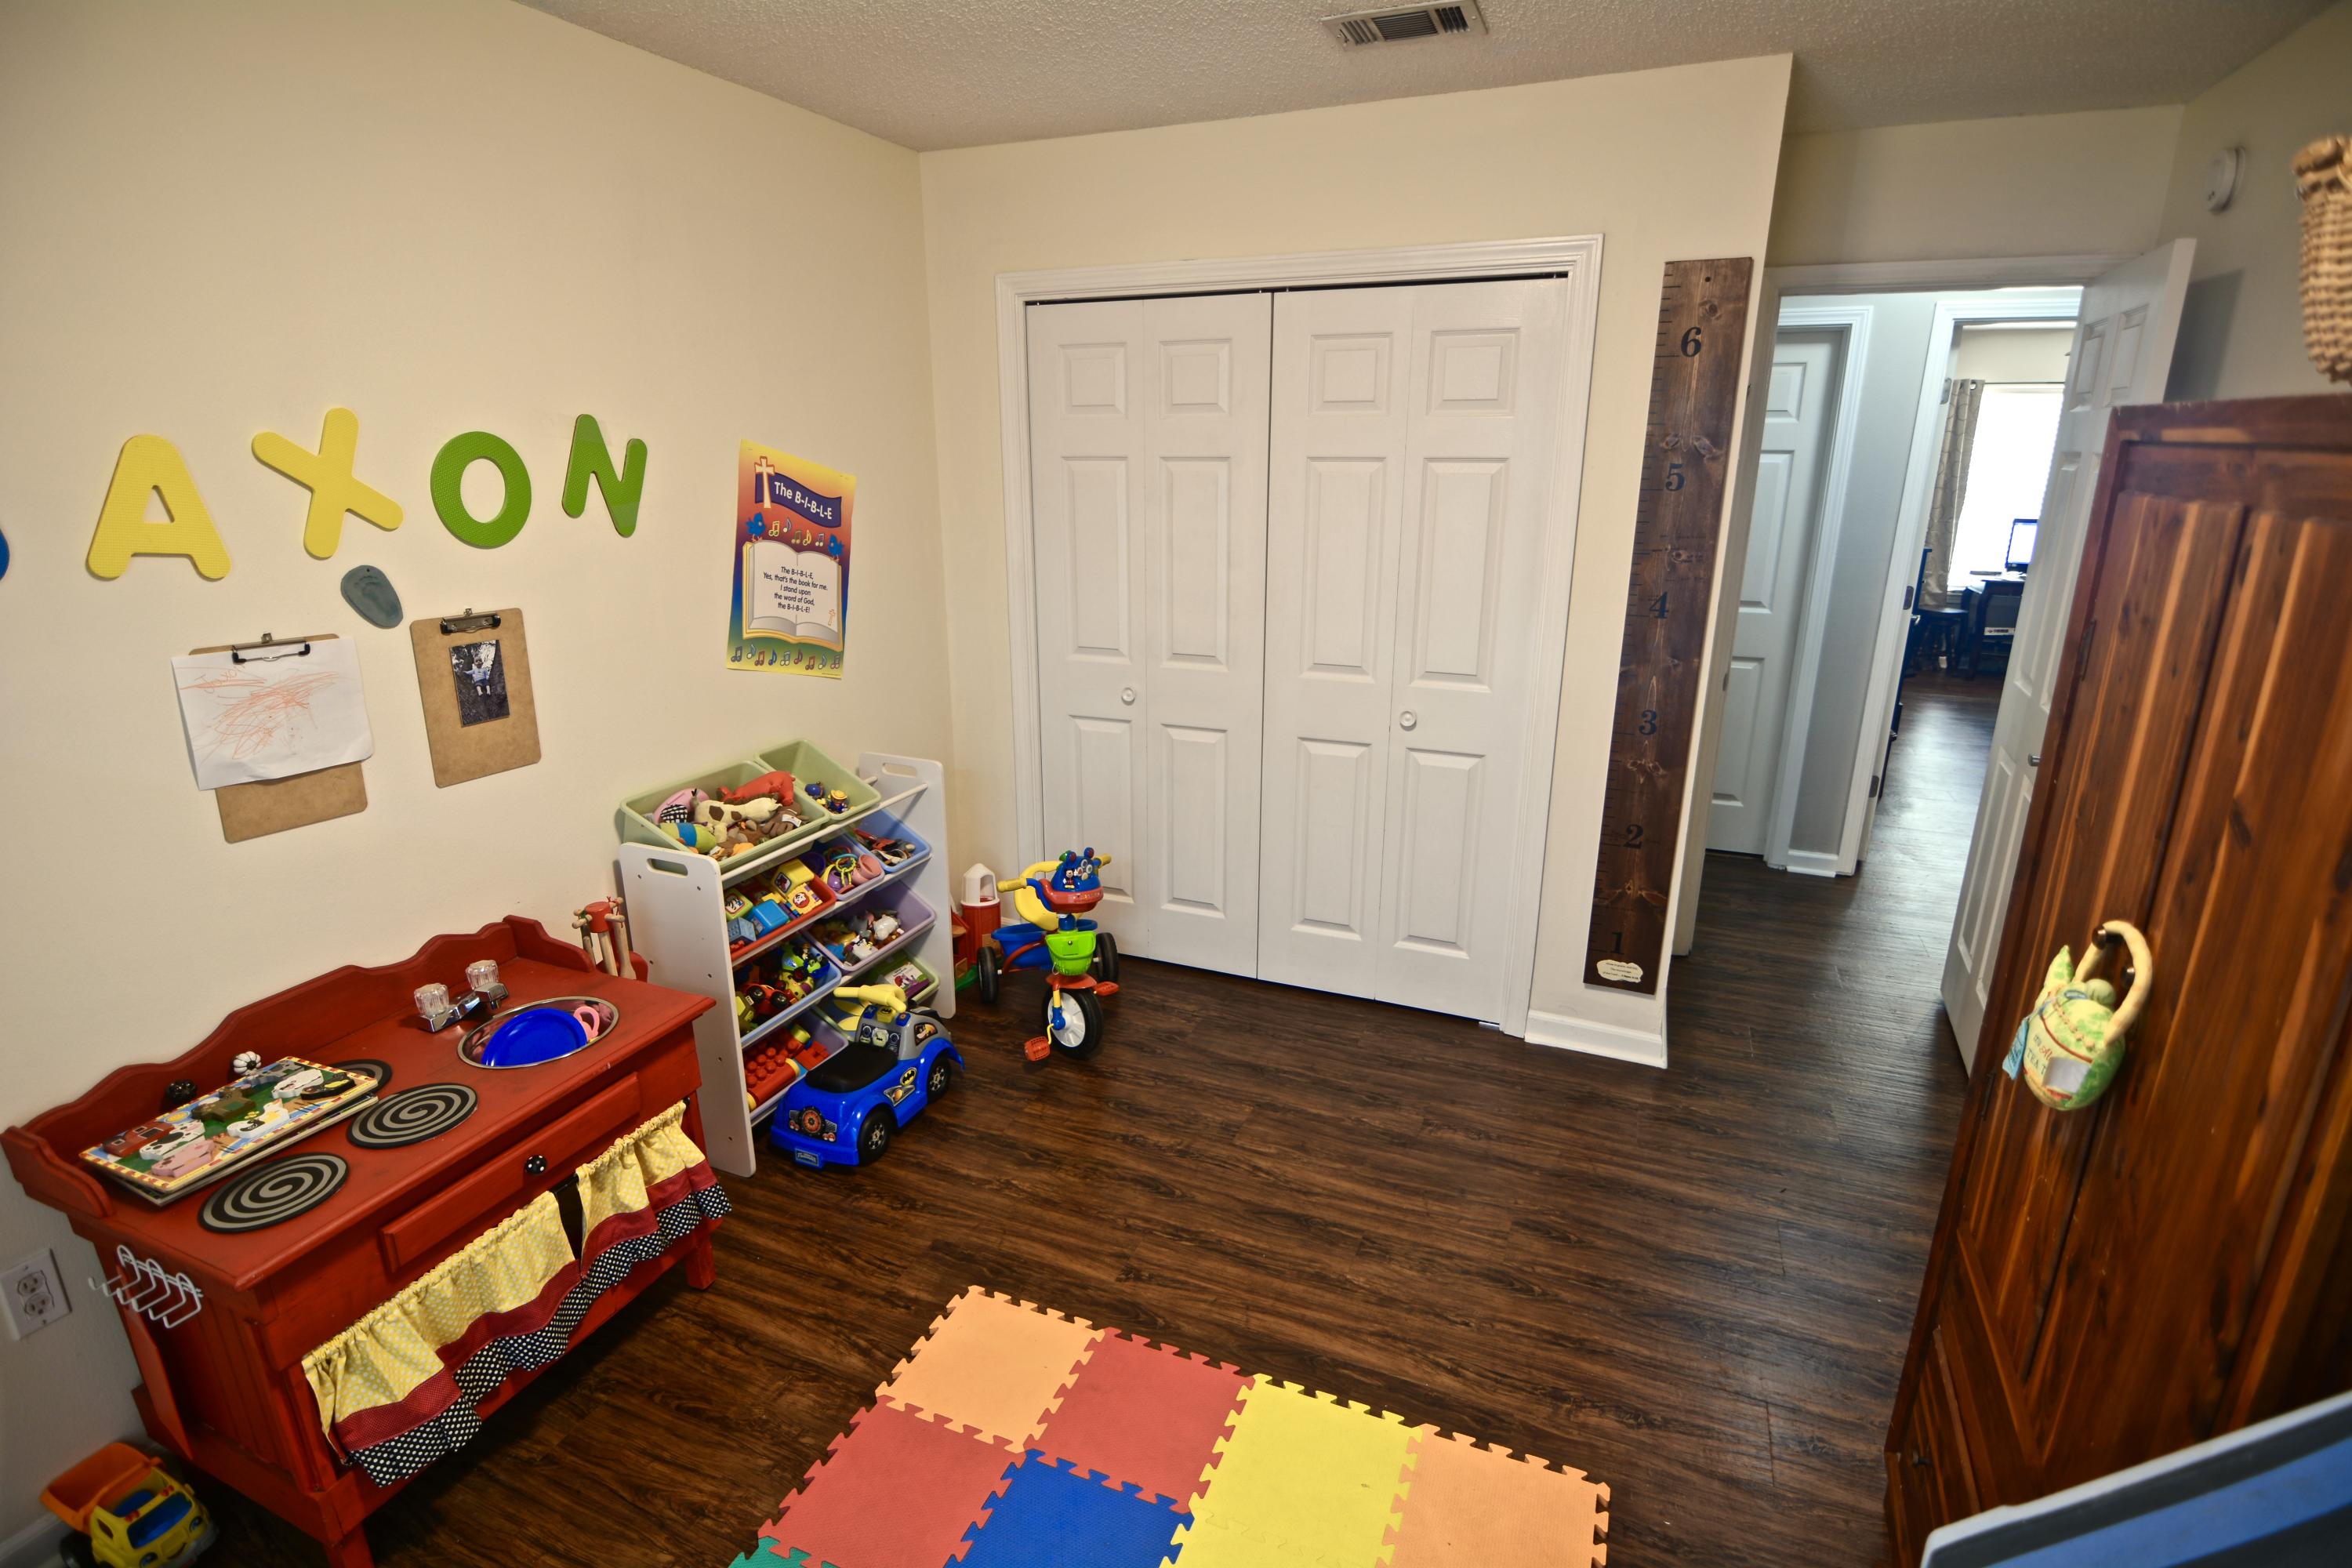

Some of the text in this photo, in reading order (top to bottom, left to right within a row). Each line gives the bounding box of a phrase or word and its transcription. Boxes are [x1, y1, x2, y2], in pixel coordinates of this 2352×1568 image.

[1680, 326, 1702, 358] 6
[1665, 463, 1686, 492] 5
[0, 407, 648, 583] AXON
[774, 481, 832, 520] The B-I-B-L-E
[763, 572, 773, 581] Yes,
[775, 574, 788, 583] that's
[798, 579, 811, 587] book
[804, 597, 815, 606] God,
[1649, 592, 1669, 619] 4
[1639, 710, 1658, 735] 3
[1623, 824, 1644, 849] 2
[1611, 931, 1624, 954] 1
